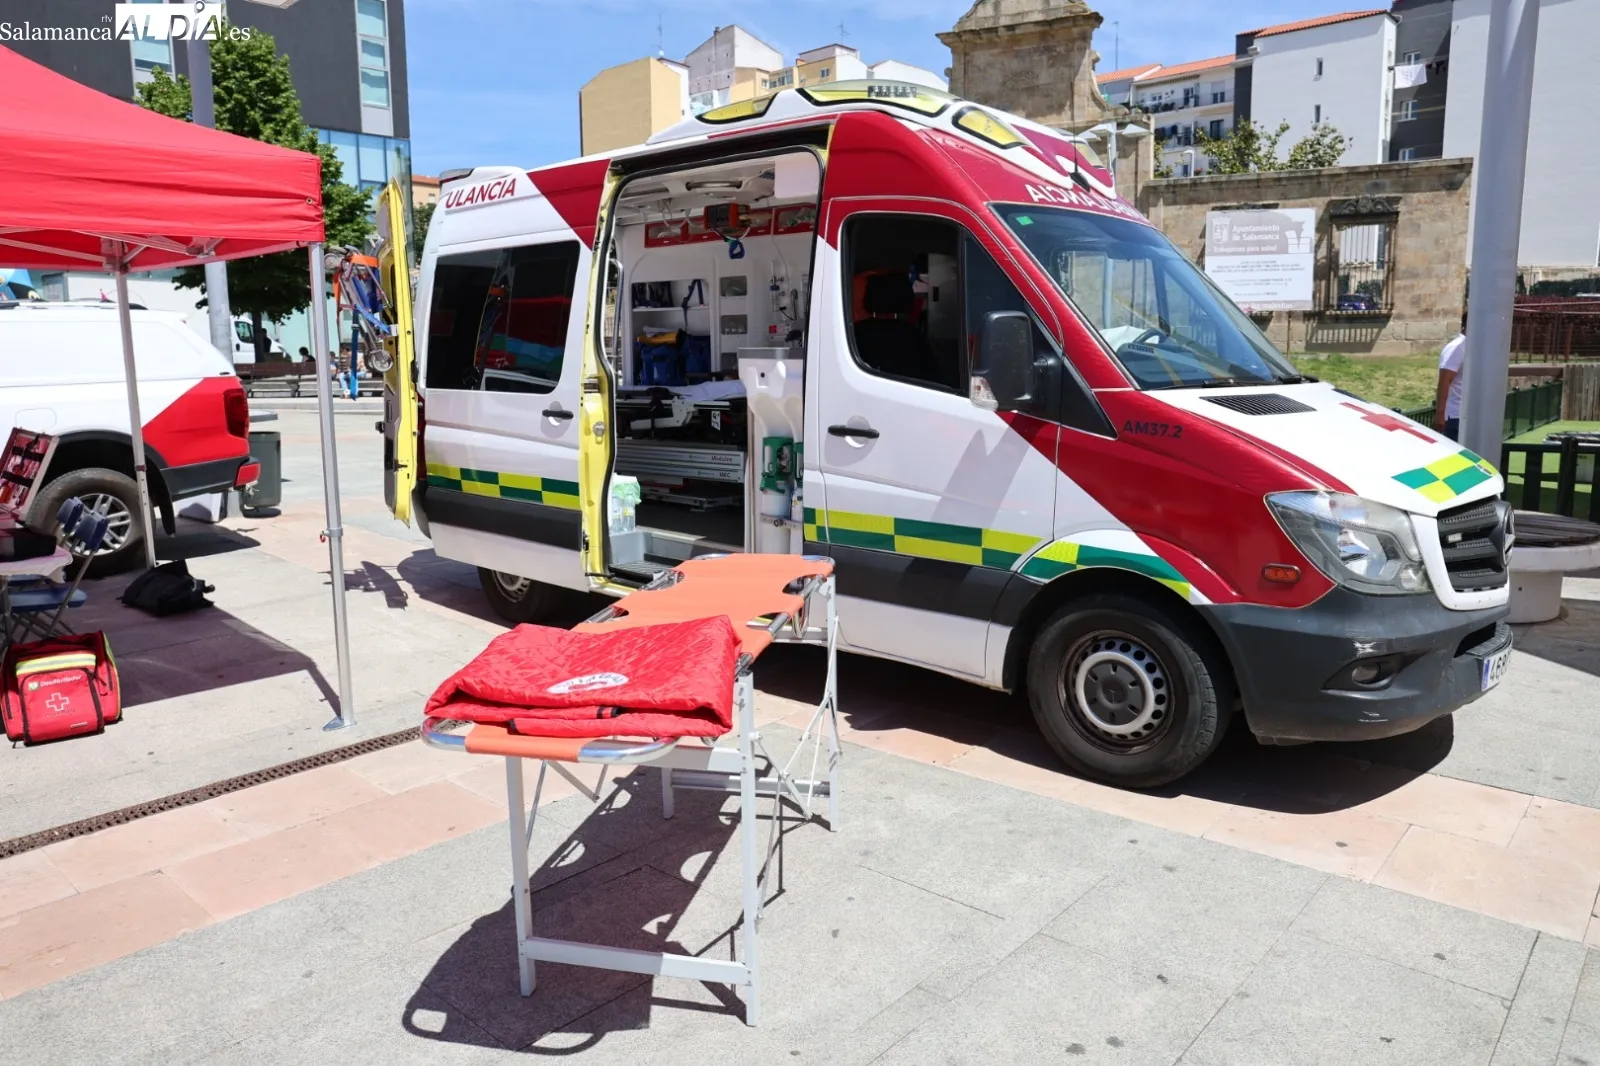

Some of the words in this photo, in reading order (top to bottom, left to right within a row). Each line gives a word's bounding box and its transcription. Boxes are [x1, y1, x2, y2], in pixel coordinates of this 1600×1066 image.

[445, 178, 516, 209] ULANCIA
[1232, 224, 1280, 233] Ayuntamiento
[1232, 233, 1242, 241] de
[1243, 233, 1280, 241] Salamanca
[1262, 301, 1293, 309] molestias
[1122, 419, 1184, 439] AM37.2
